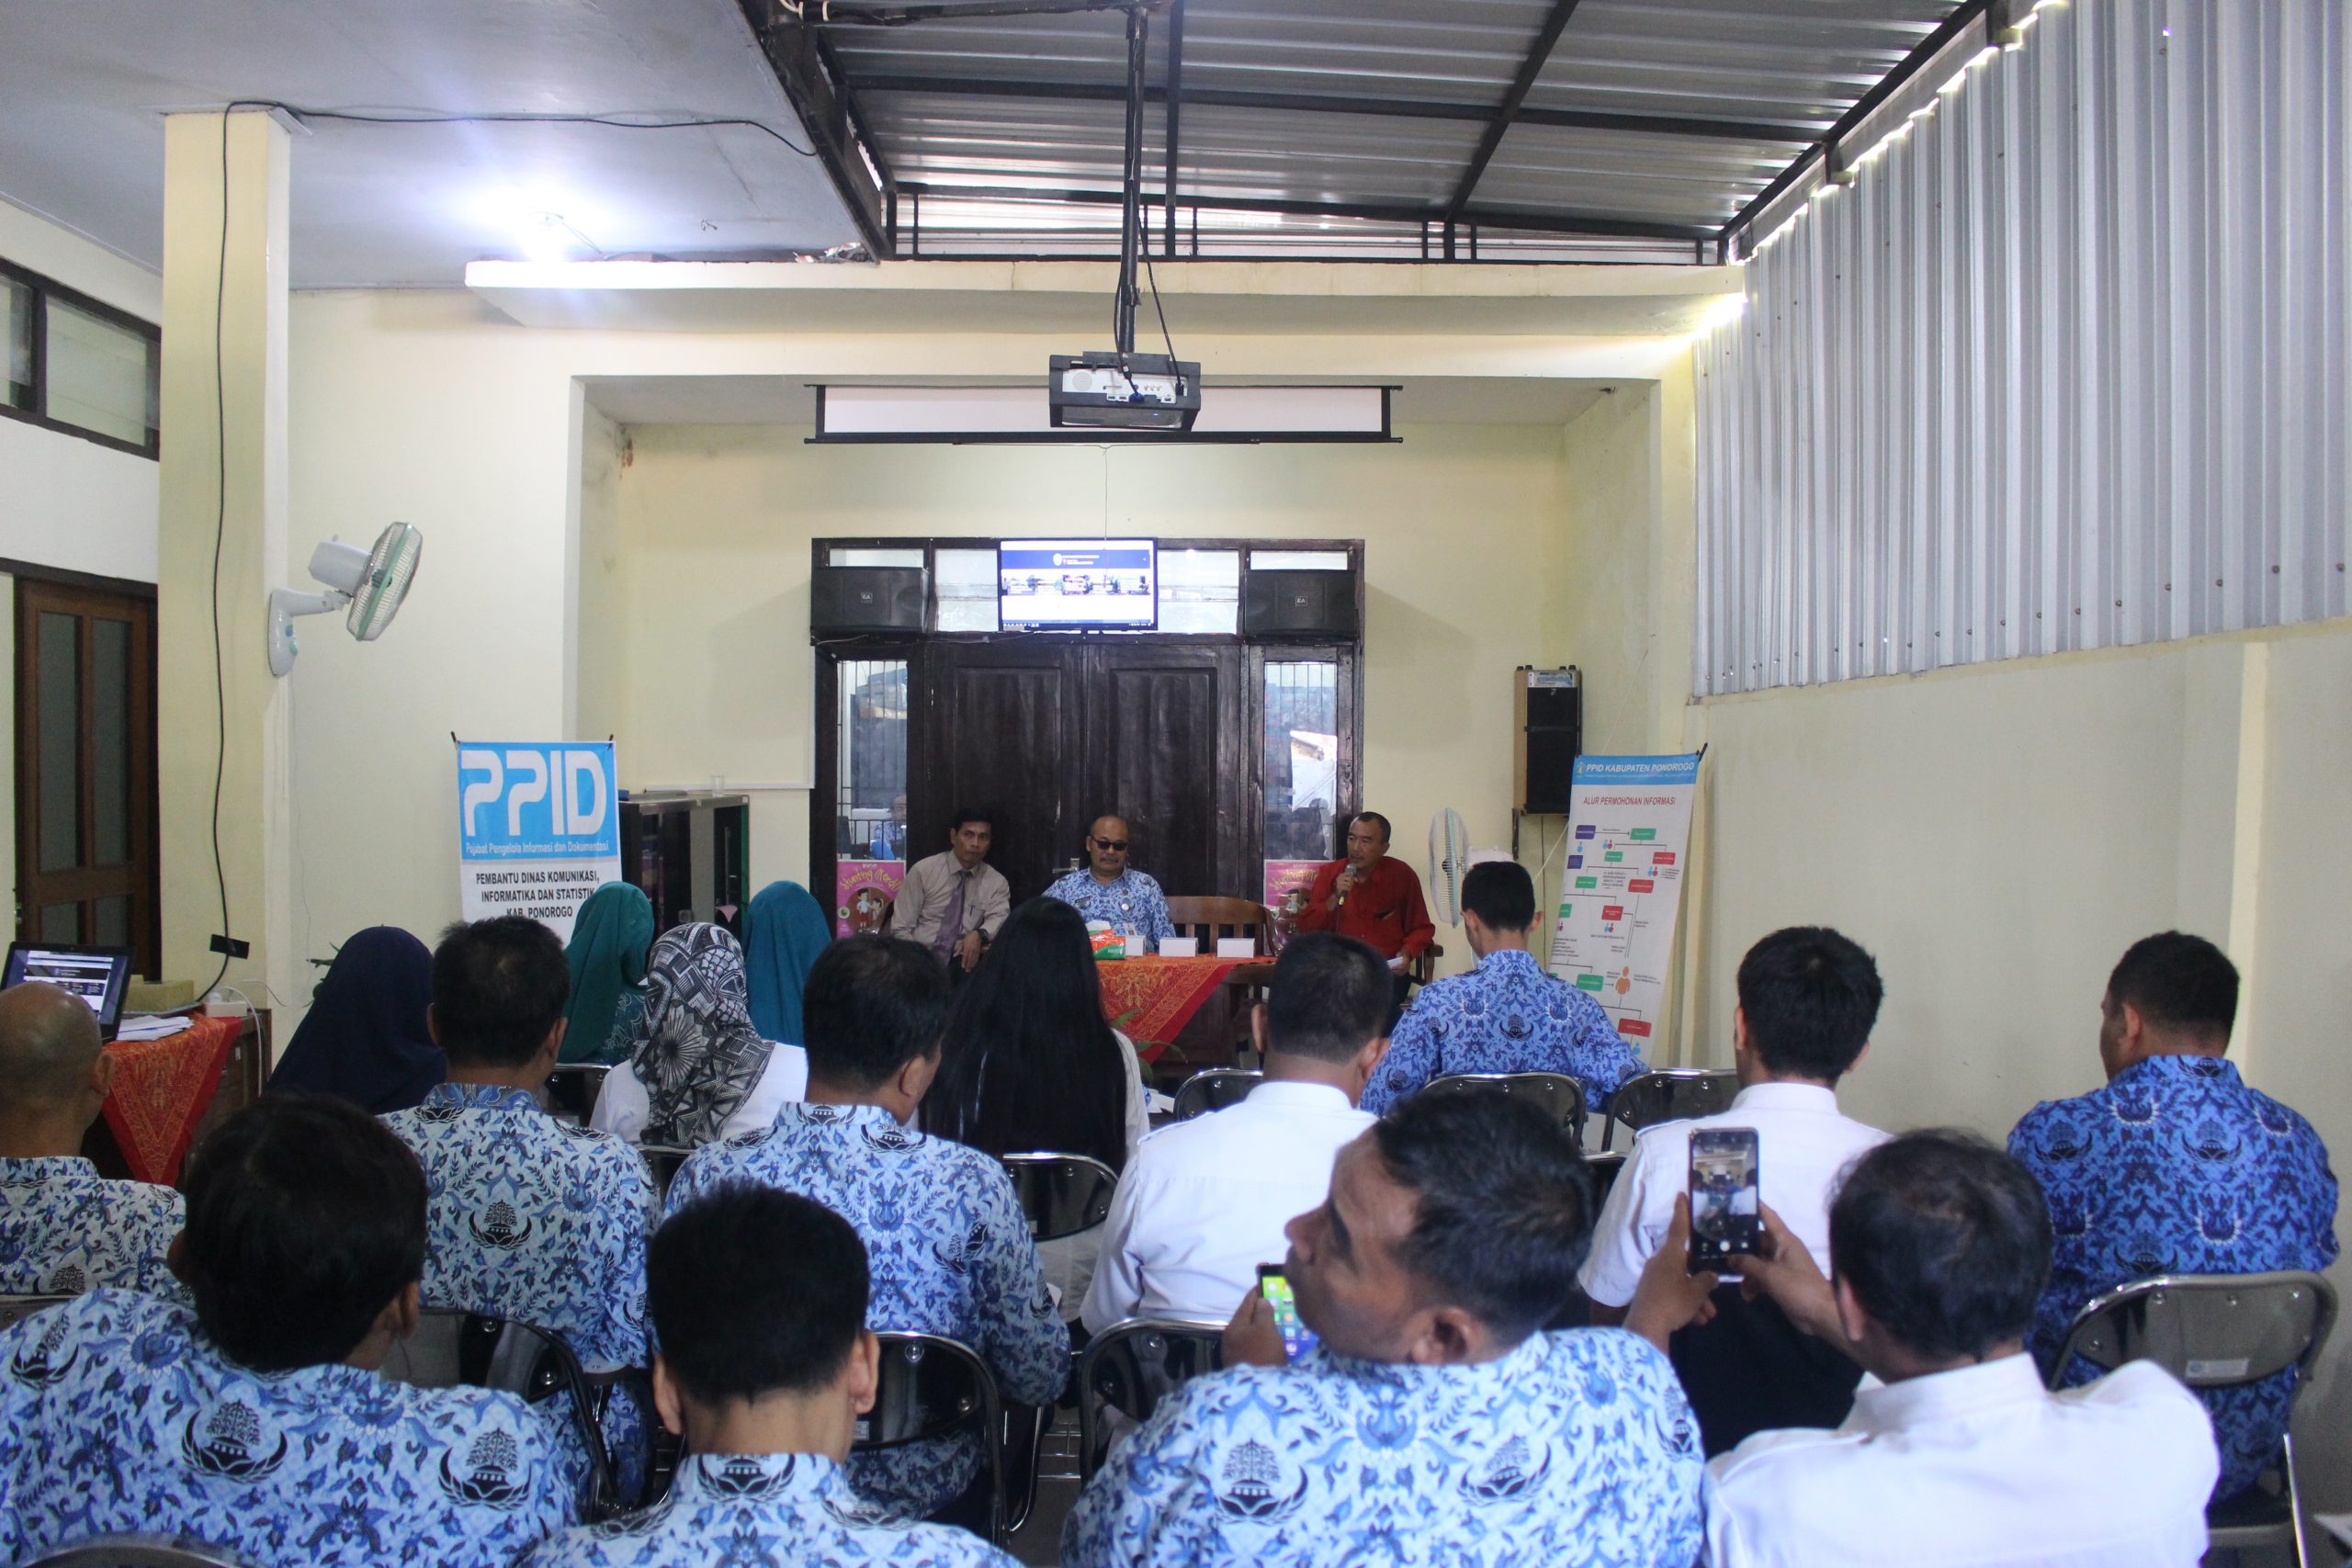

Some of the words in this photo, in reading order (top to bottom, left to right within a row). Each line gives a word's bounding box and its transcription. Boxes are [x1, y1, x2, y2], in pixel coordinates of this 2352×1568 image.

[1586, 763, 1604, 773] PPID
[1605, 763, 1650, 773] KABUPATEN
[1651, 762, 1695, 772] PONOROGO
[461, 750, 607, 837] PPID
[1583, 796, 1600, 806] ALUR
[1600, 796, 1643, 806] PERMOHONAN
[1643, 796, 1677, 806] INFORMASI
[489, 841, 522, 856] Pengelola
[523, 841, 553, 853] Informasi
[554, 840, 567, 852] dan
[568, 840, 609, 852] Dokumentasi
[476, 873, 519, 884] PEMBANTU
[521, 872, 546, 883] DINAS
[548, 870, 600, 883] KOMUNIKASI,
[481, 889, 536, 902] INFORMATIKA
[537, 889, 554, 900] DAN
[528, 906, 572, 918] PONOROGO
